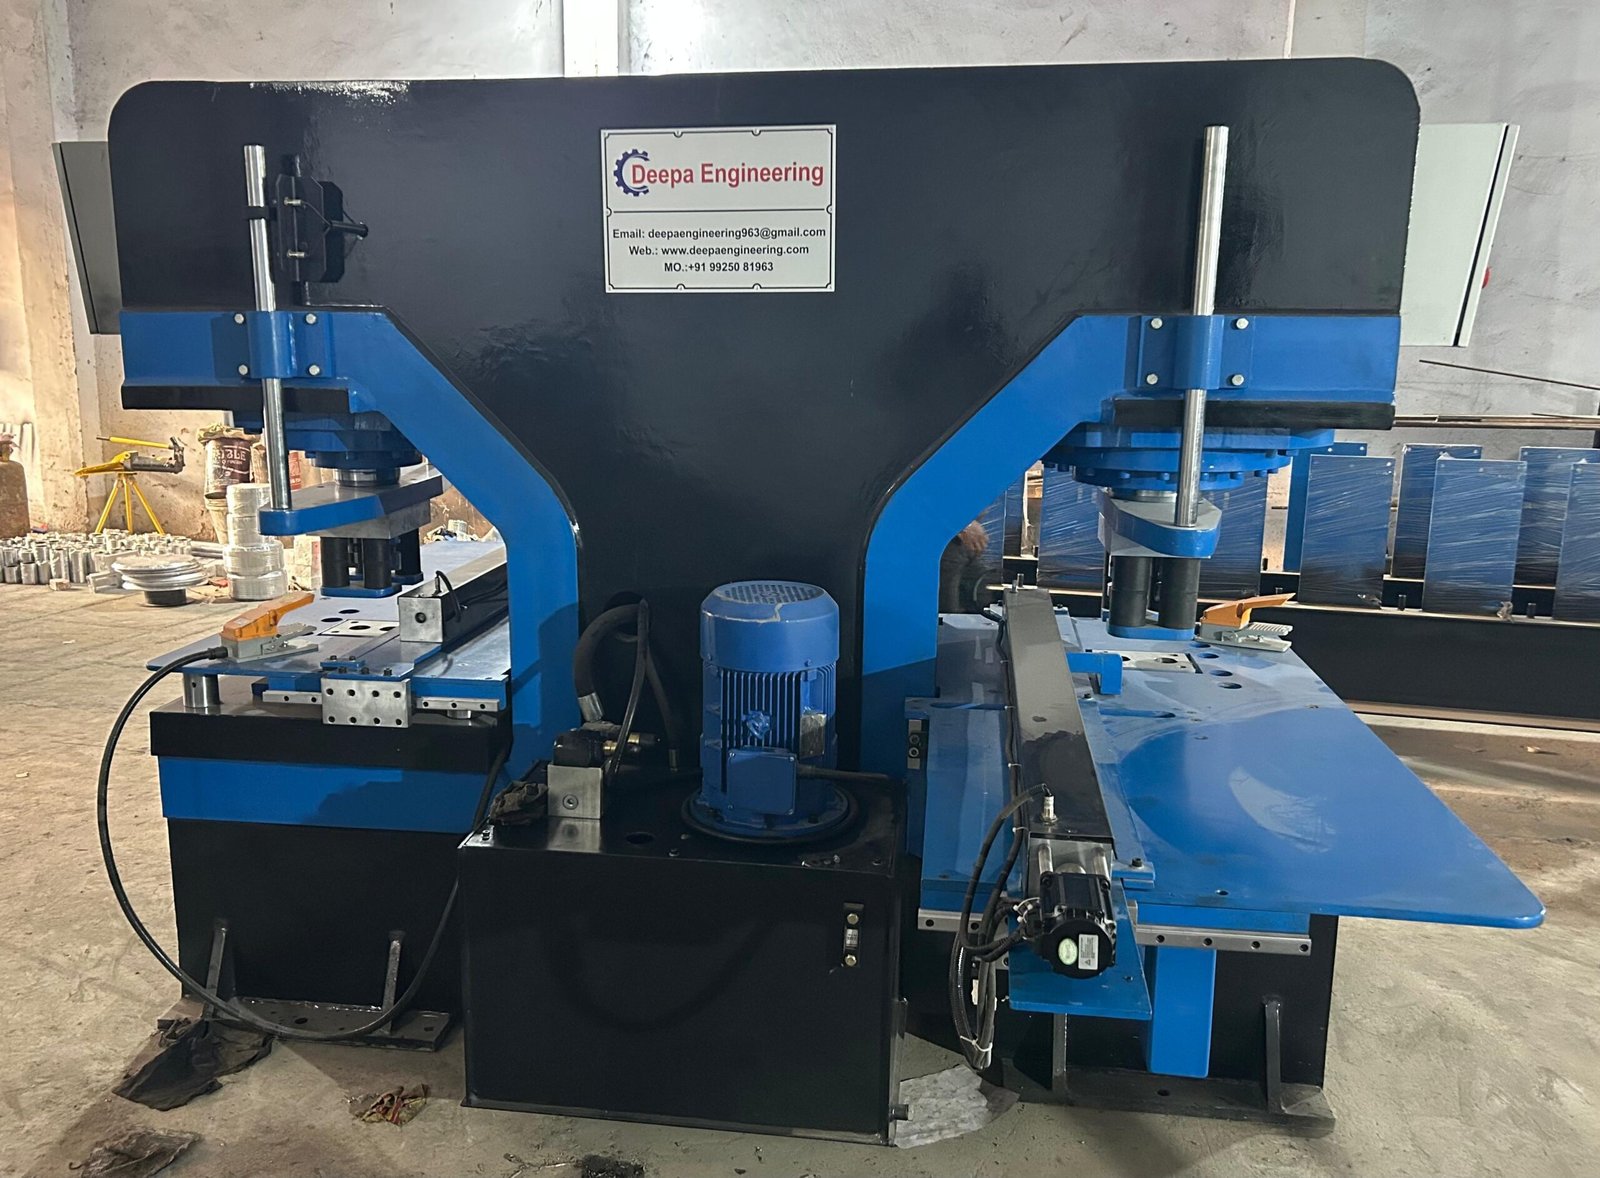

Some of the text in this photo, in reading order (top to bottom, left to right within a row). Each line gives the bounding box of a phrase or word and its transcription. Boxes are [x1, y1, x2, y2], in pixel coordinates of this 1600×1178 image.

[632, 162, 824, 188] Deepa Engineering
[612, 228, 826, 240] Email: deepaengineering963@gmail.com
[629, 245, 809, 257] Web.: www.deepaengineering.com
[664, 262, 774, 272] MO.:+91 99250 81963
